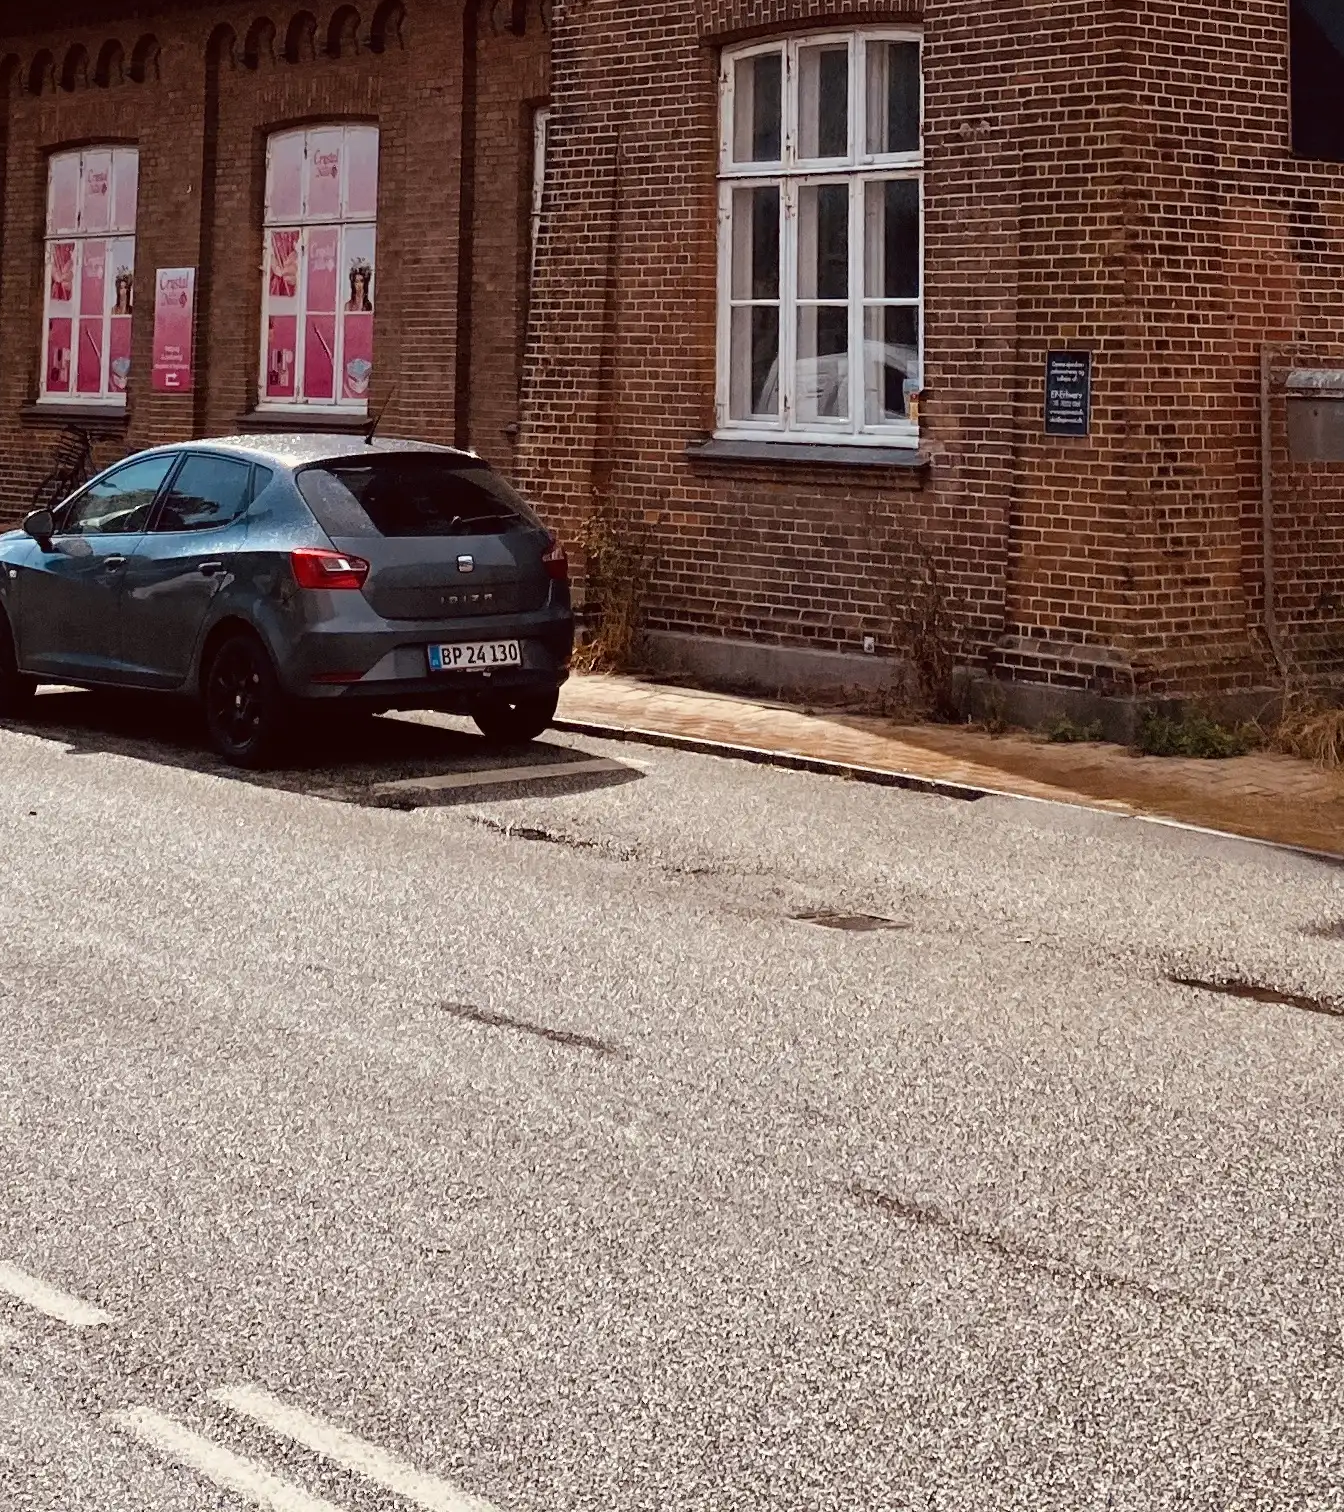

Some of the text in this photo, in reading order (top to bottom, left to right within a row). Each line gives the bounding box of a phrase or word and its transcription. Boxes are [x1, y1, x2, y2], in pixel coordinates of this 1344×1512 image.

[441, 644, 518, 665] BP 24 130
